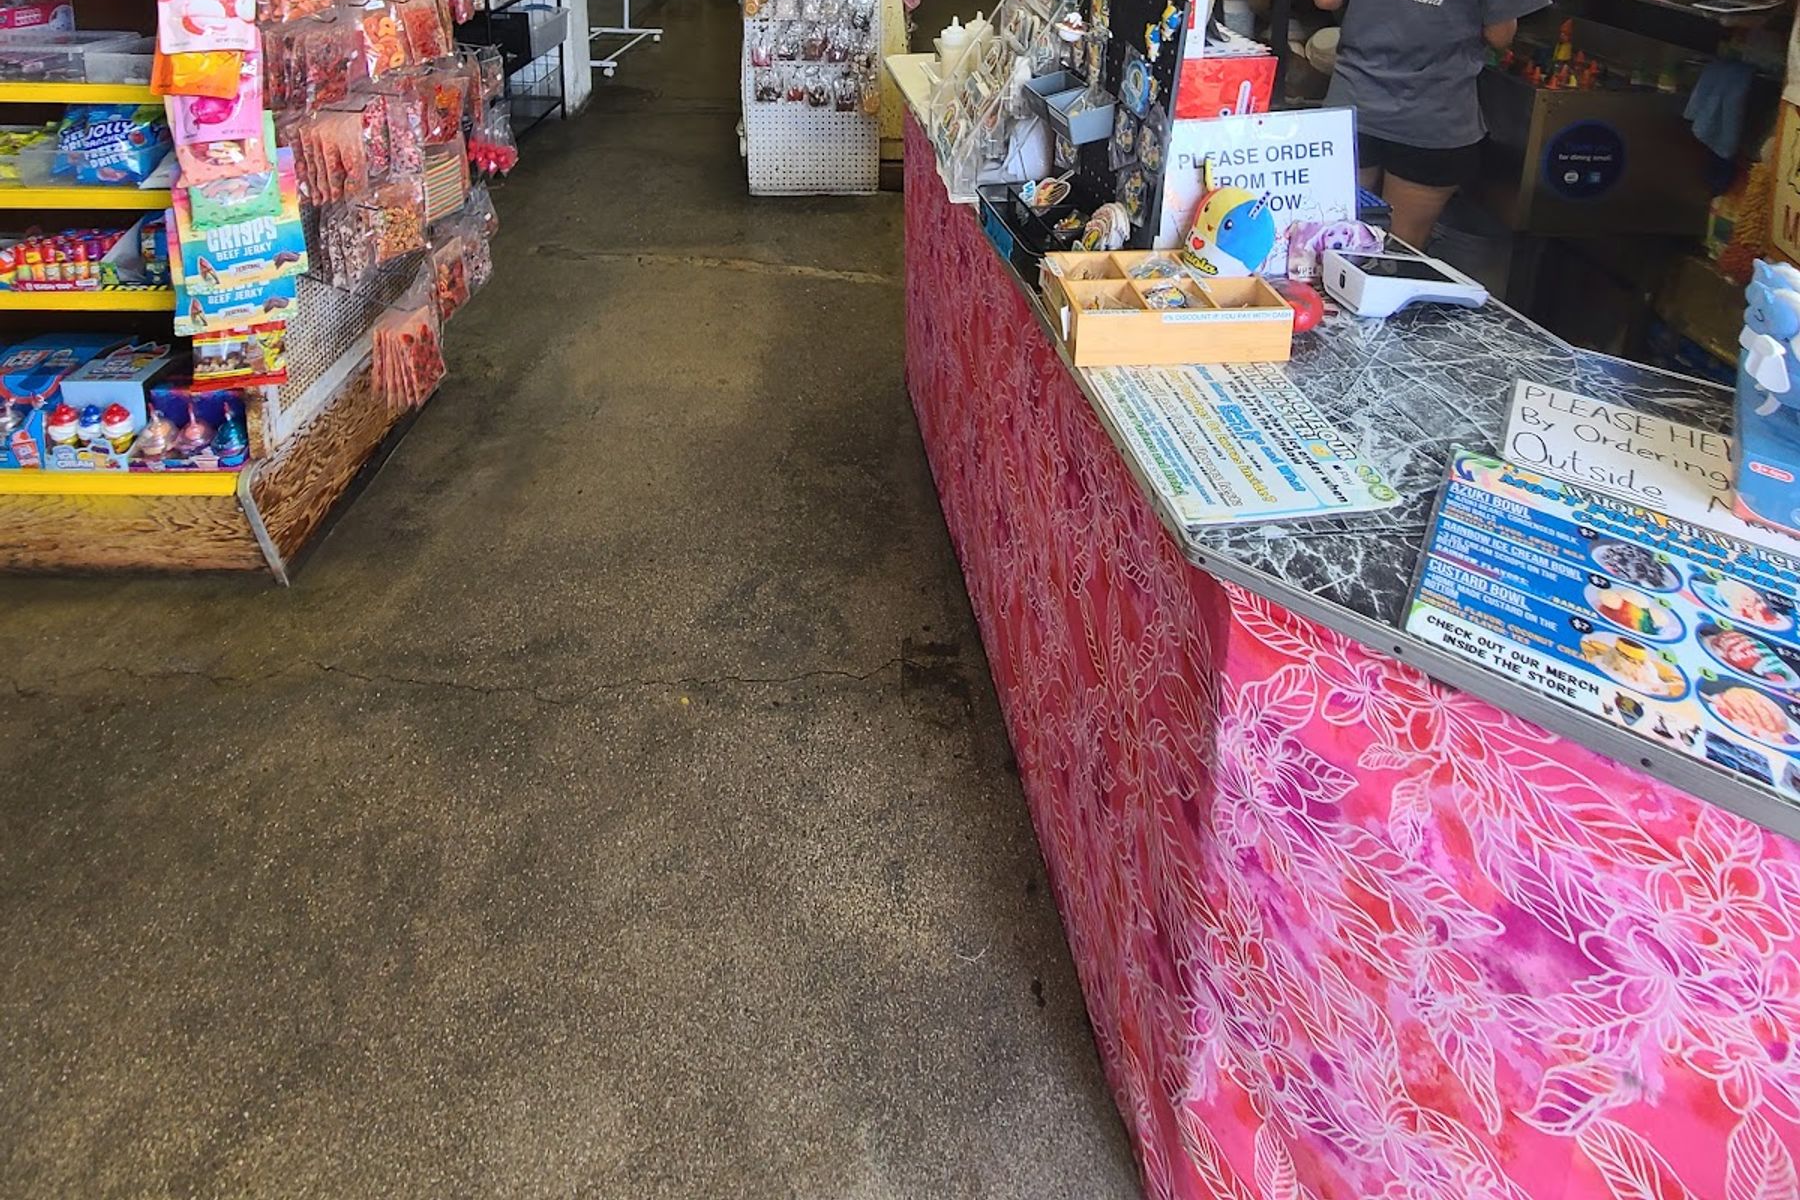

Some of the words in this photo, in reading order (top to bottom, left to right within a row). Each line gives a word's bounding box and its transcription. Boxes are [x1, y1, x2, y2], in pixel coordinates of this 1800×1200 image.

[85, 120, 135, 140] JOLLY
[1178, 148, 1260, 171] PLEASE
[1265, 140, 1335, 162] ORDER
[1271, 168, 1310, 187] THE
[206, 216, 278, 252] CRISPS
[216, 249, 241, 262] BEEF
[243, 241, 273, 257] JERKY
[208, 293, 232, 304] BEEF
[233, 287, 264, 301] JERKY
[1525, 385, 1656, 440] PLEASE
[1265, 414, 1292, 436] shave
[1297, 450, 1326, 474] order
[1319, 476, 1350, 501] when
[1268, 431, 1305, 464] window
[1315, 430, 1361, 461] OUR
[1512, 431, 1663, 497] Outside
[1573, 423, 1733, 492] Ordering
[1449, 480, 1490, 504] AZUKI
[1491, 496, 1531, 519] BOWL
[1441, 519, 1492, 547] RAINBOW
[1491, 538, 1508, 552] ICE
[1510, 545, 1548, 567] CREAM
[1550, 560, 1583, 582] BOWL
[1463, 540, 1493, 556] CREAM
[1427, 558, 1488, 592] CUSTARD
[1488, 583, 1533, 612] BOWL
[1482, 594, 1522, 618] CUSTARD
[1539, 617, 1557, 632] THE
[1425, 614, 1473, 641] CHECK
[1476, 635, 1506, 655] OUT
[1509, 649, 1540, 670] OUR
[1544, 664, 1600, 695] MERCH
[1441, 632, 1487, 660] INSIDE
[1490, 653, 1522, 675] THE
[1526, 669, 1578, 699] STORE
